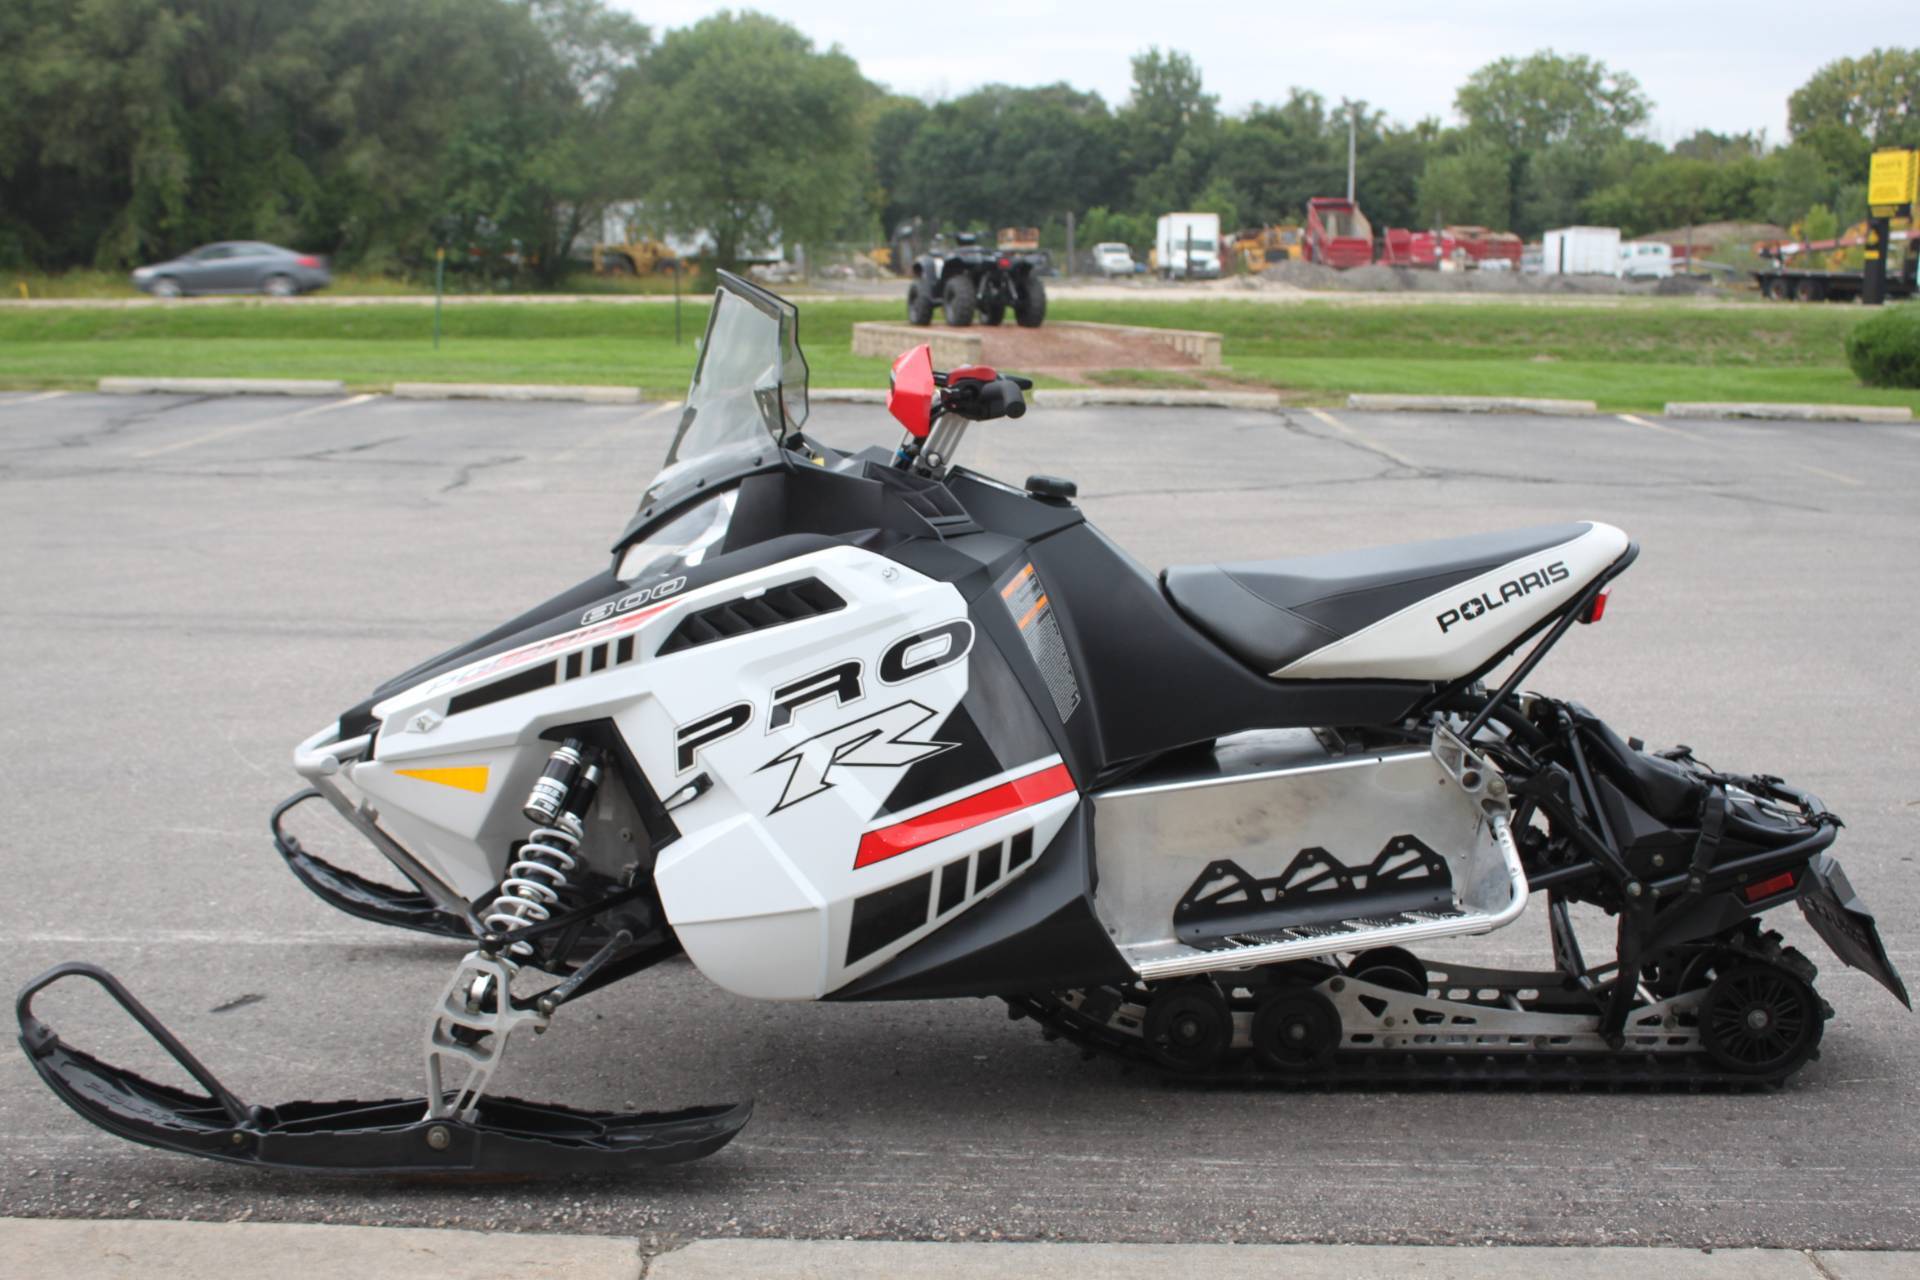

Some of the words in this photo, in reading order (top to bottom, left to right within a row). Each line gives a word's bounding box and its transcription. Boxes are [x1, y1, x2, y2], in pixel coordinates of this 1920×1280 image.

[581, 576, 687, 625] 800
[1436, 561, 1570, 633] POLARIS
[673, 618, 976, 777] PRO
